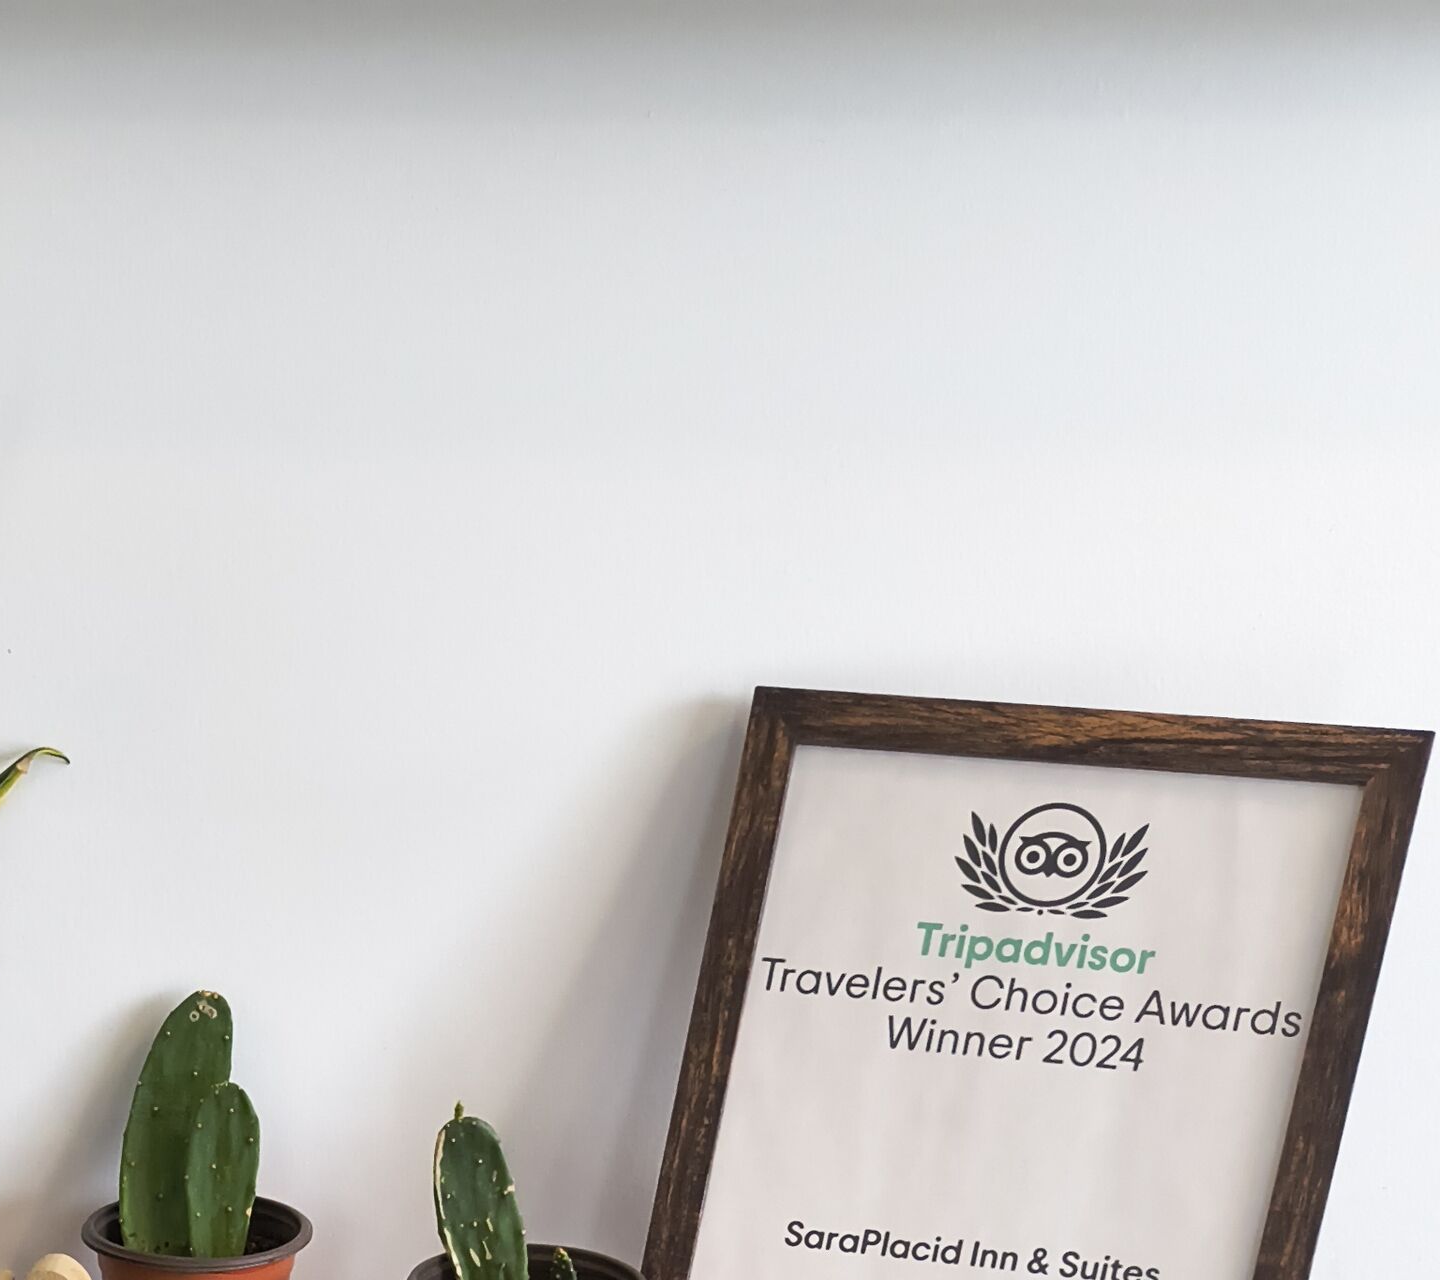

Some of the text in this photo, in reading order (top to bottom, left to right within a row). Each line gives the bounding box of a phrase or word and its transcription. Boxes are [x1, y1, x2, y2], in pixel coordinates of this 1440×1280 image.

[917, 920, 1157, 977] Tripadvisor
[760, 955, 1304, 1039] Travelers’ Choice Awards
[887, 1013, 1146, 1074] Winner 2024
[783, 1219, 966, 1268] SaraPlacid
[969, 1239, 1020, 1273] Inn
[1026, 1246, 1051, 1277] &
